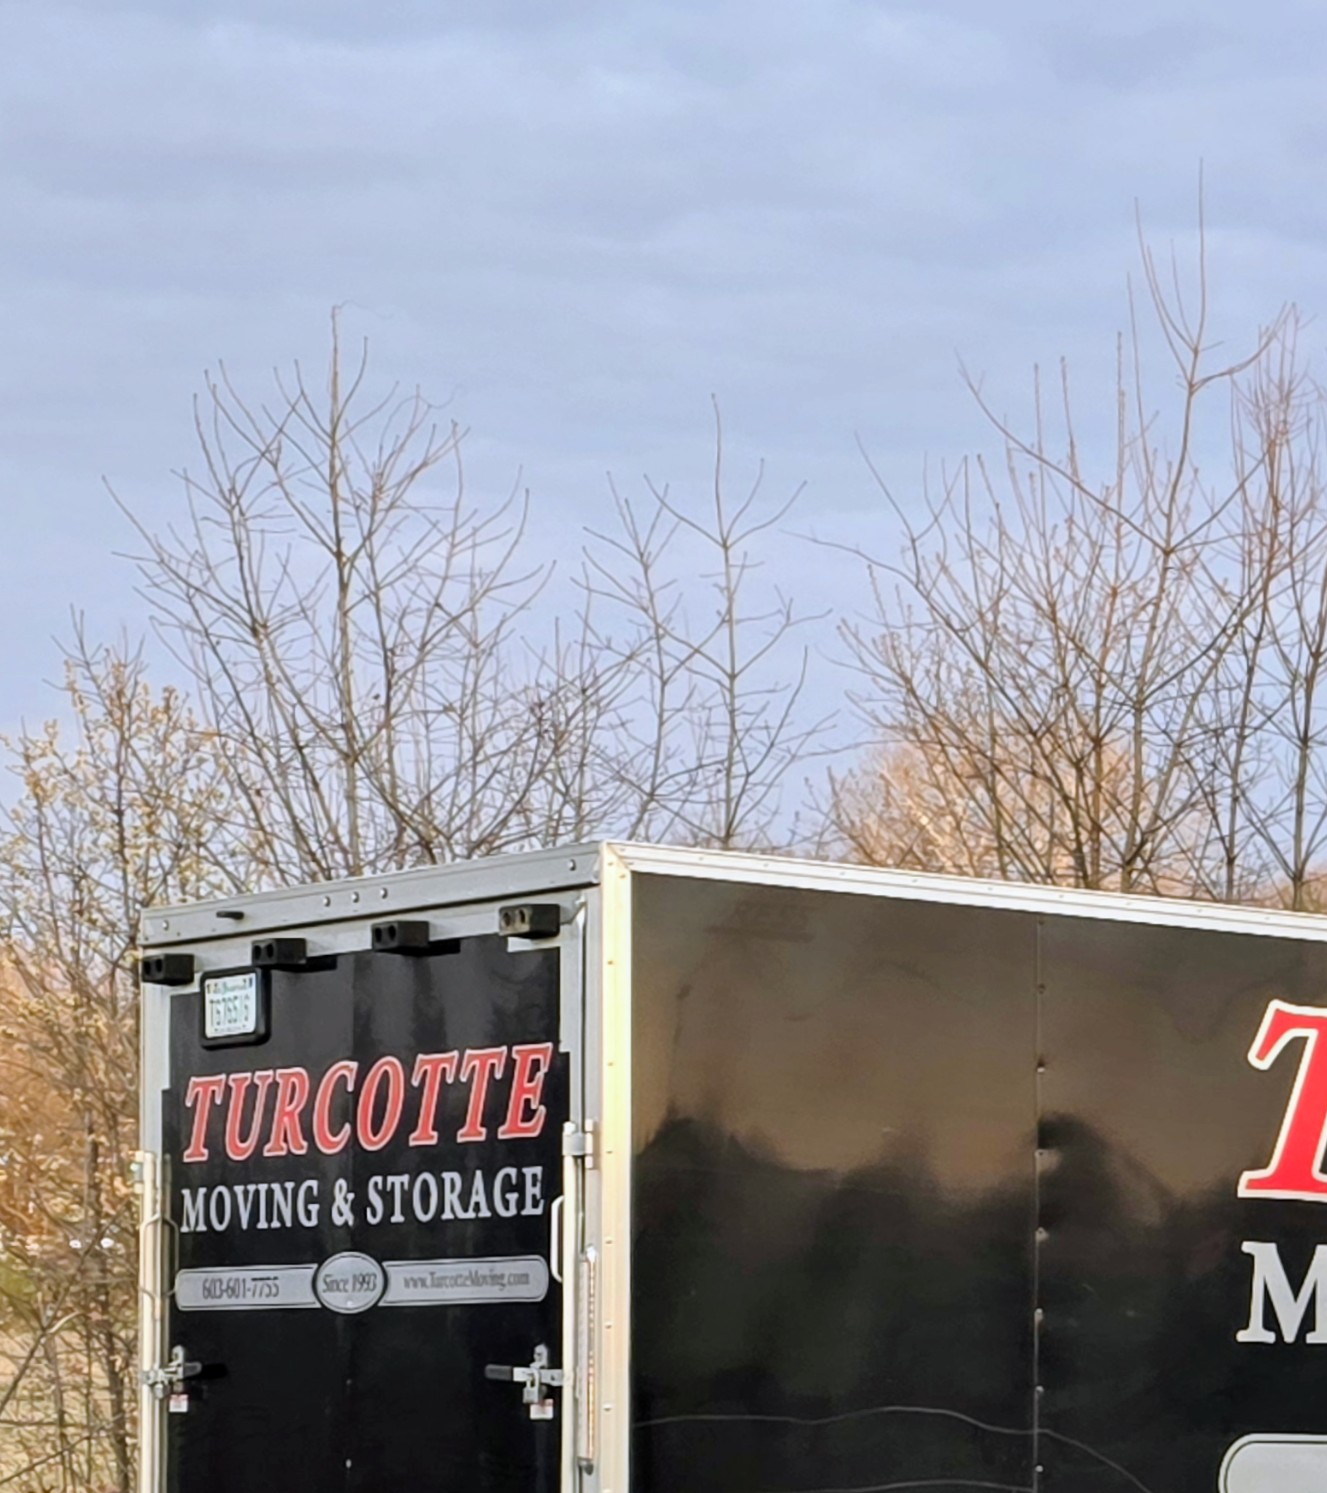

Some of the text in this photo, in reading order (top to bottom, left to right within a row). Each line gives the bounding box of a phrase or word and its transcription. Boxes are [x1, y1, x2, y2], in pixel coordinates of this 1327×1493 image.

[183, 1042, 553, 1163] TURCOTTE
[181, 1166, 544, 1233] MOVING & STORAGE
[202, 1276, 280, 1299] 603-601-7755
[322, 1272, 377, 1294] Since 1993
[404, 1268, 530, 1291] www.TurcotteMoving.com
